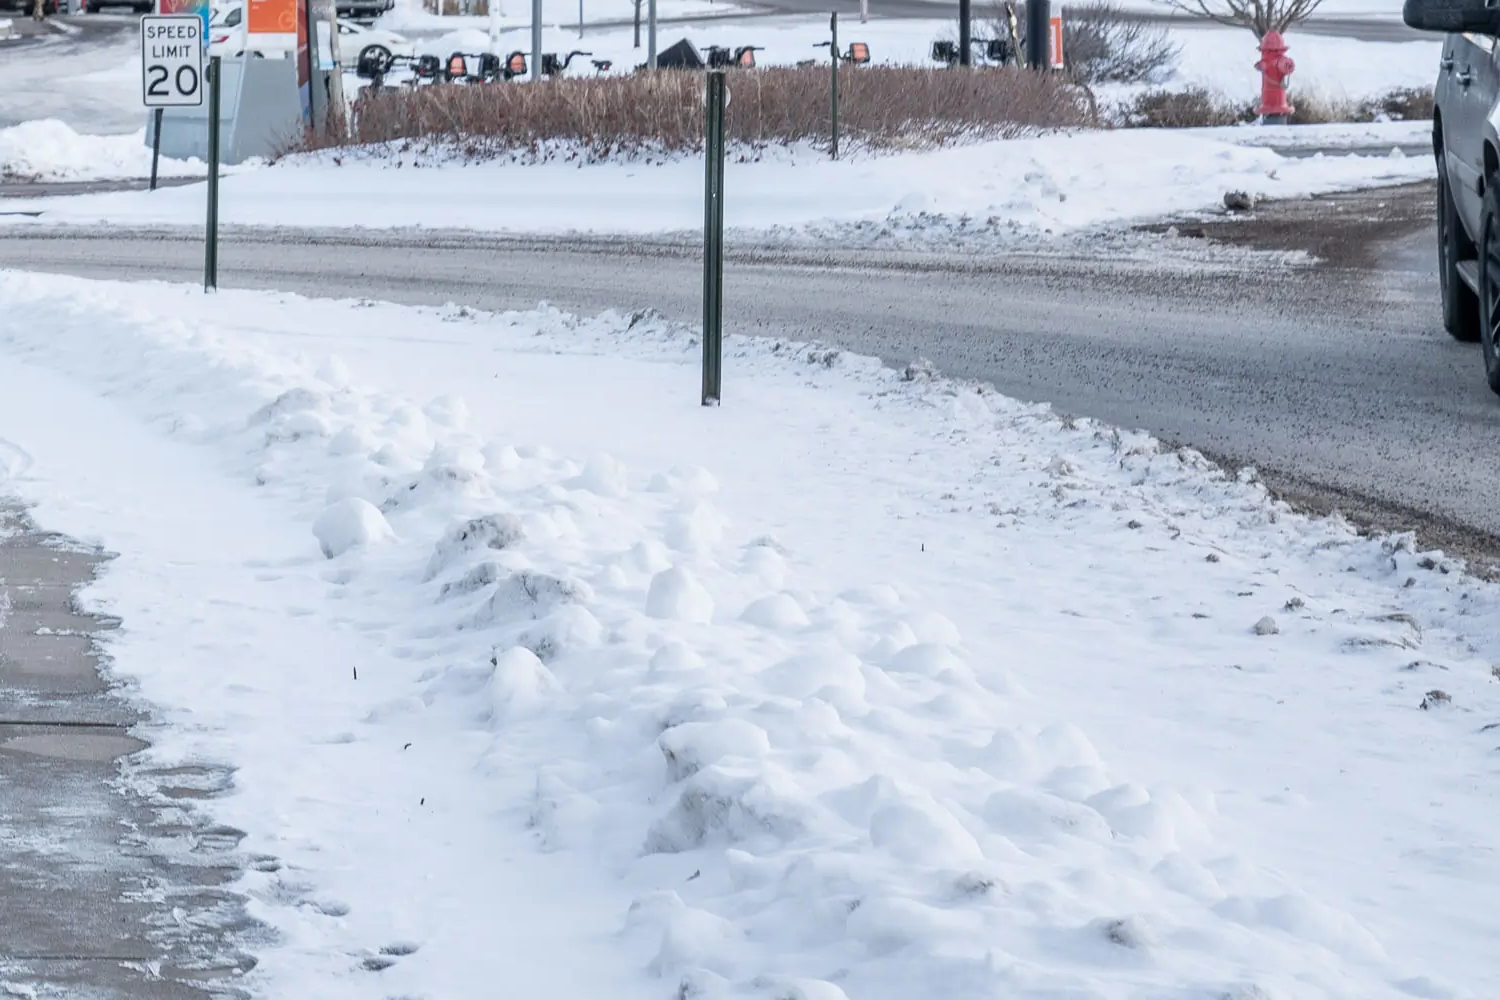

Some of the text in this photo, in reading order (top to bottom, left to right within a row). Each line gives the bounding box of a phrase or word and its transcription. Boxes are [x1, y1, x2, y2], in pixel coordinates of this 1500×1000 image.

[147, 25, 197, 39] SPEED
[152, 45, 192, 58] LIMIT
[147, 64, 199, 96] 20
